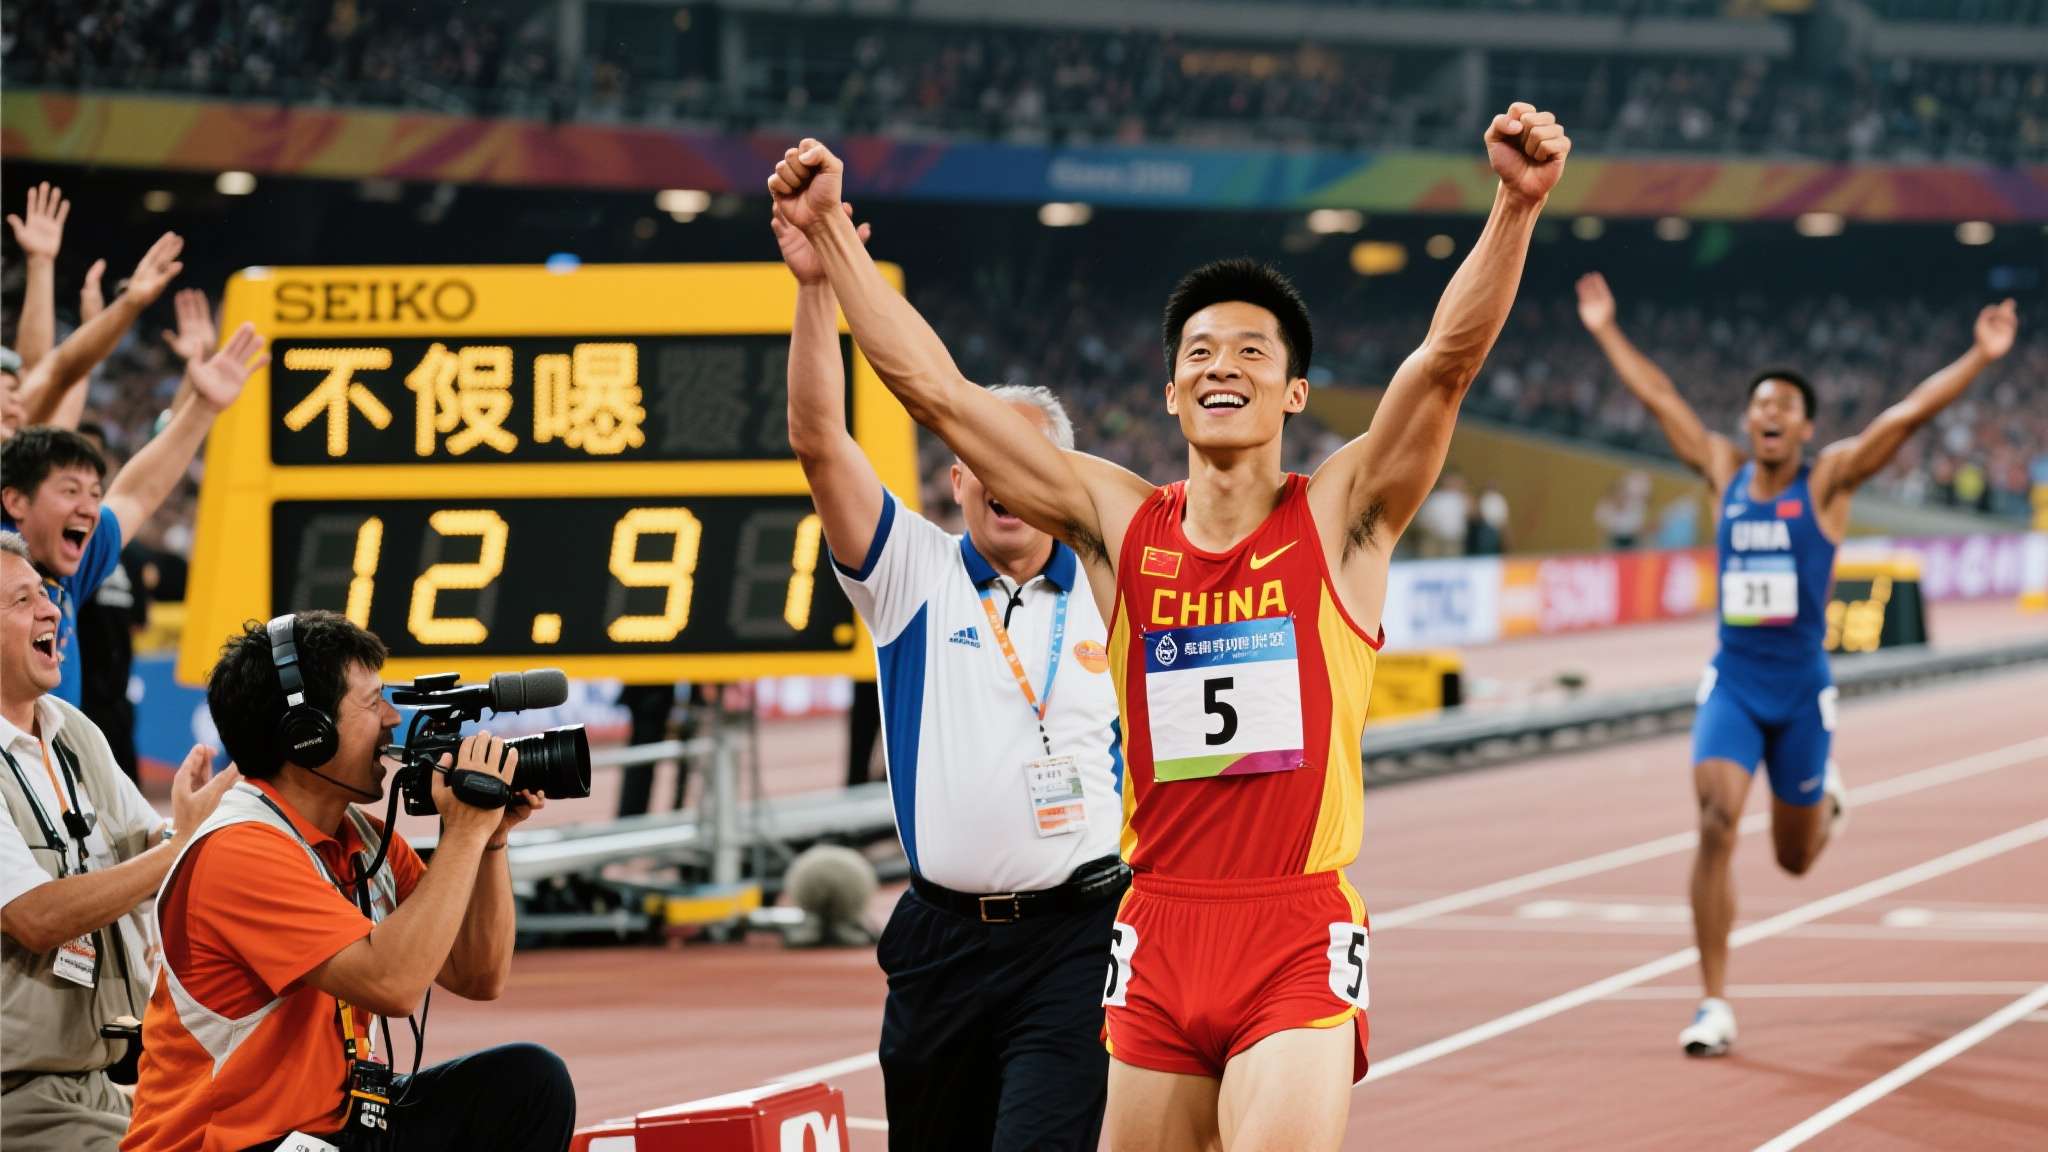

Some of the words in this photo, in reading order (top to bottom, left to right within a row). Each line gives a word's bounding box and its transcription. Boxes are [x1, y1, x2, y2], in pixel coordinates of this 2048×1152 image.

[273, 280, 476, 325] SEIKO
[1203, 676, 1239, 746] 5
[1346, 931, 1365, 1000] 5
